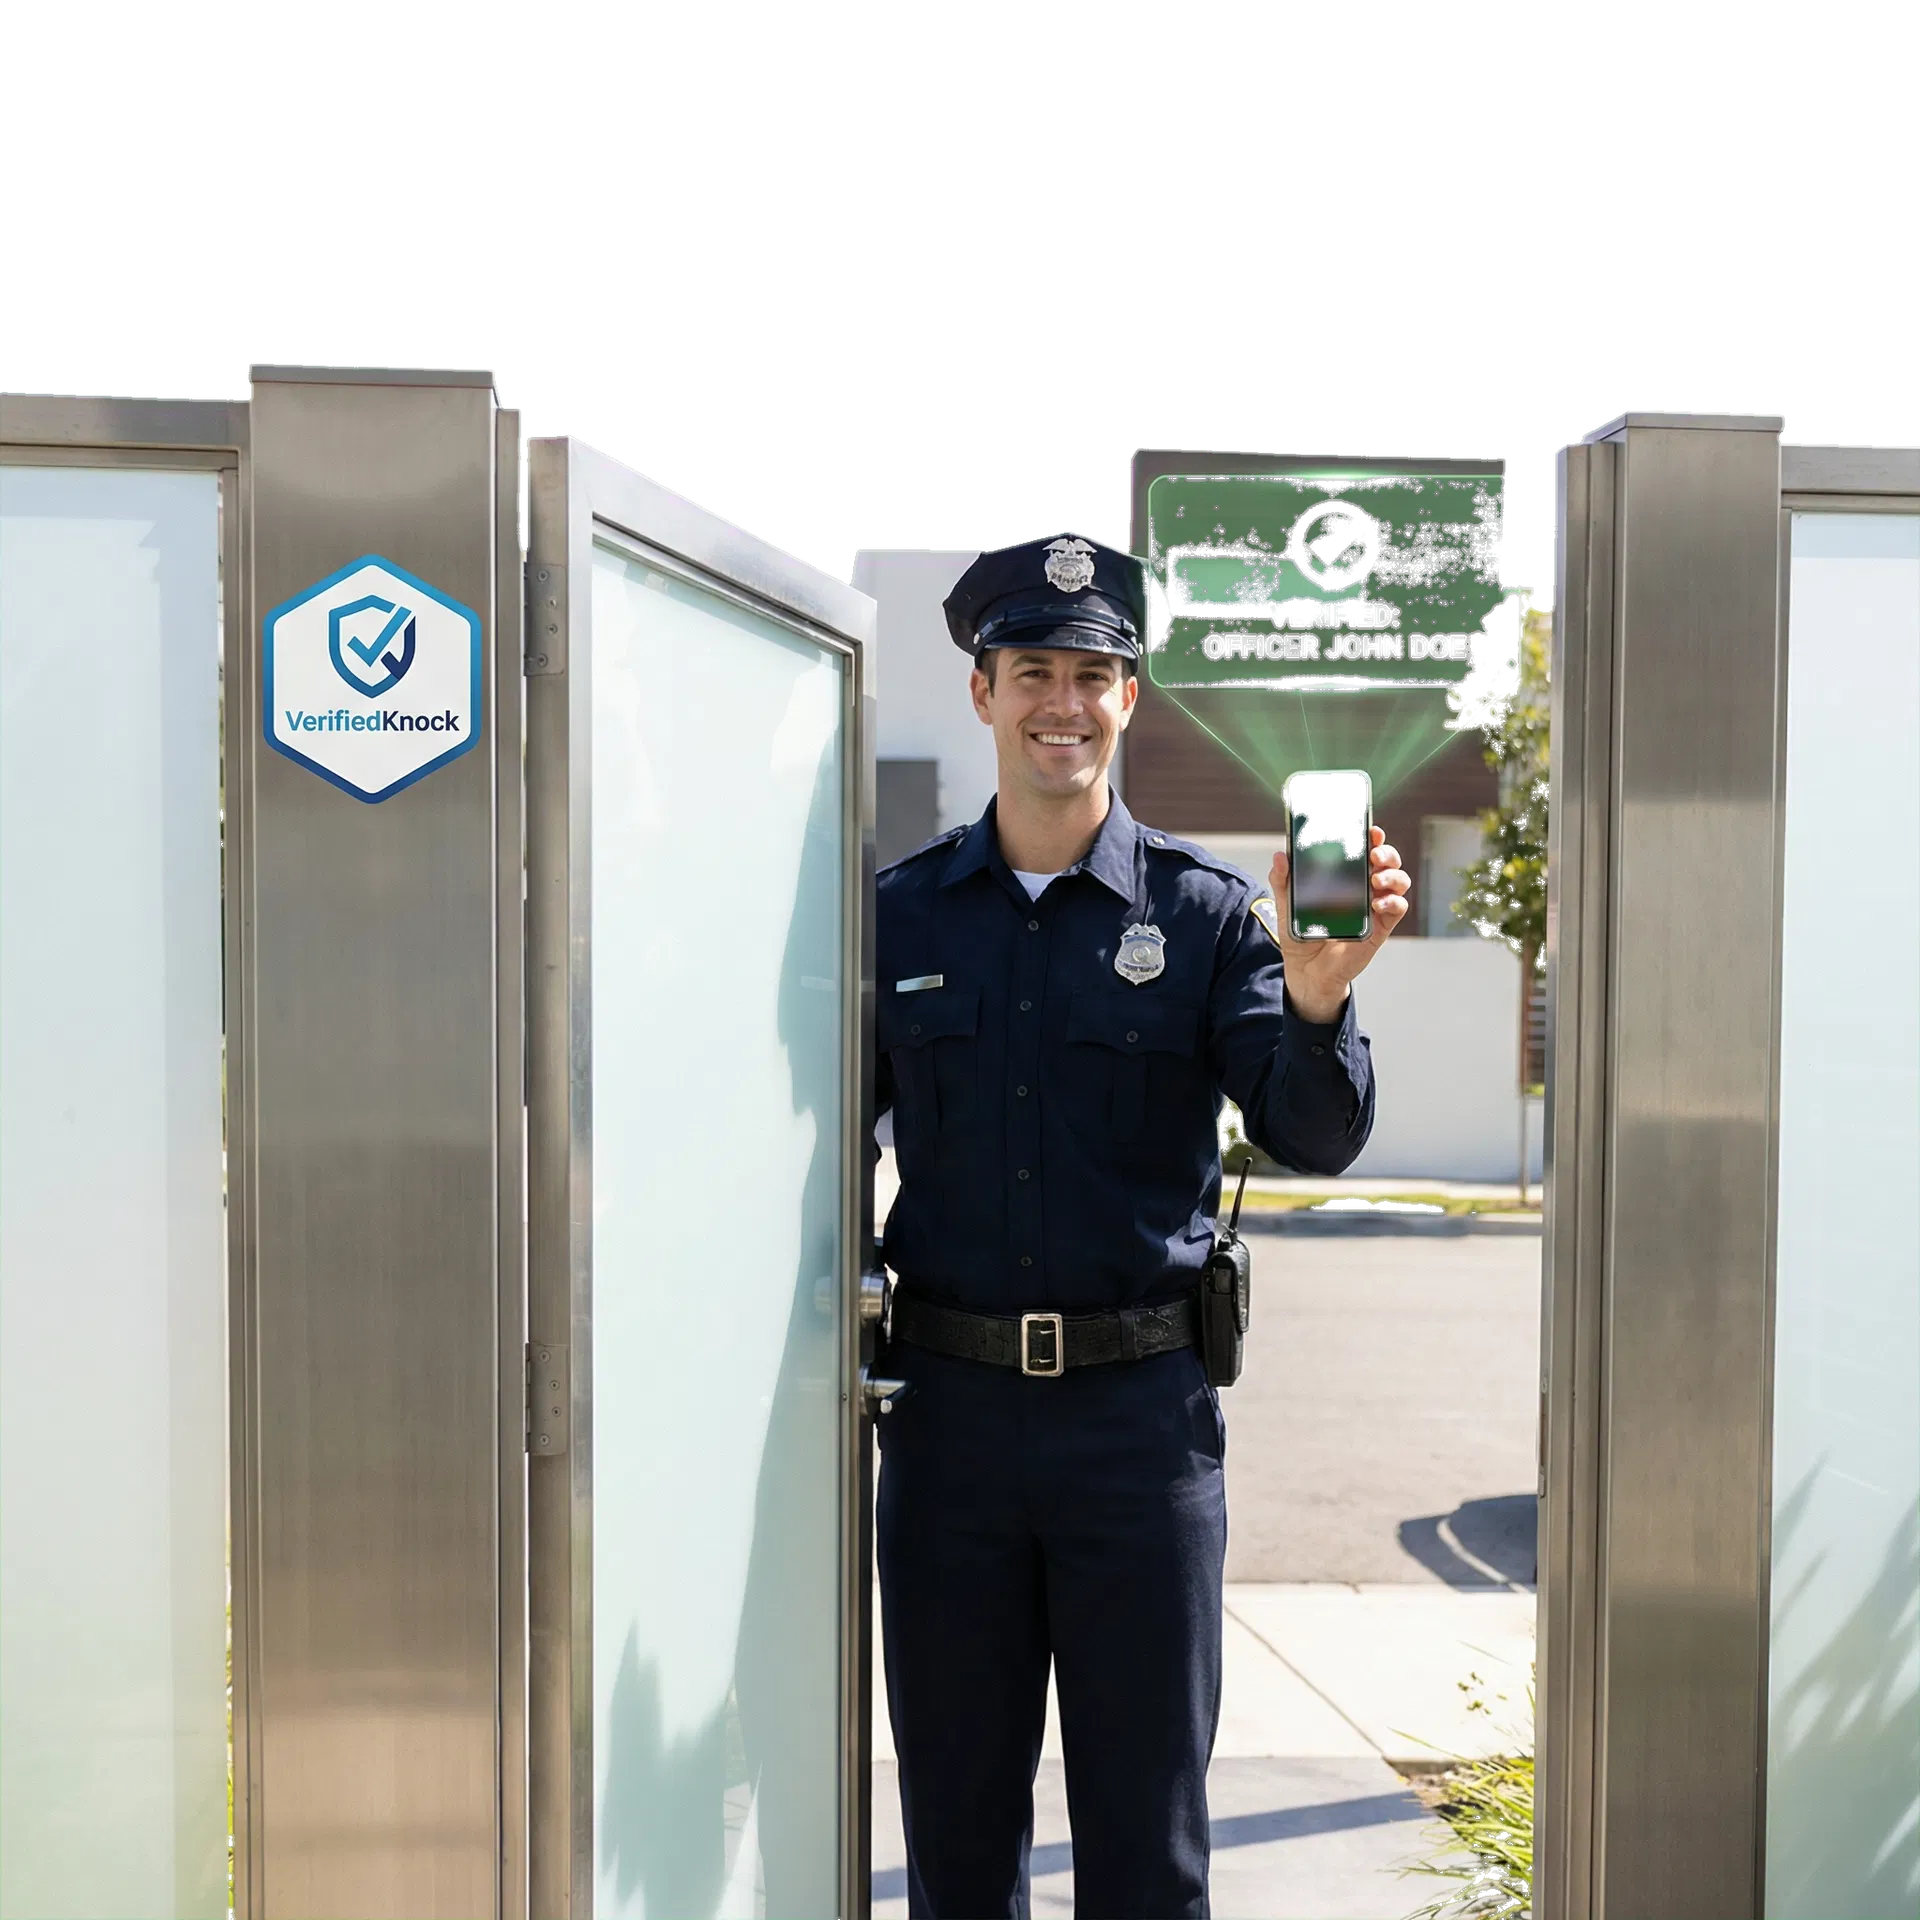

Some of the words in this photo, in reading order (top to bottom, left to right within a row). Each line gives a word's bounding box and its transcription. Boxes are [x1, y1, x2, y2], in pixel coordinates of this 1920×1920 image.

[1270, 604, 1399, 627] VERIFED:
[1204, 635, 1319, 659] OFFICER
[1325, 635, 1402, 659] JOHN
[1411, 635, 1467, 659] DOE
[285, 709, 460, 732] VerifiedKnock
